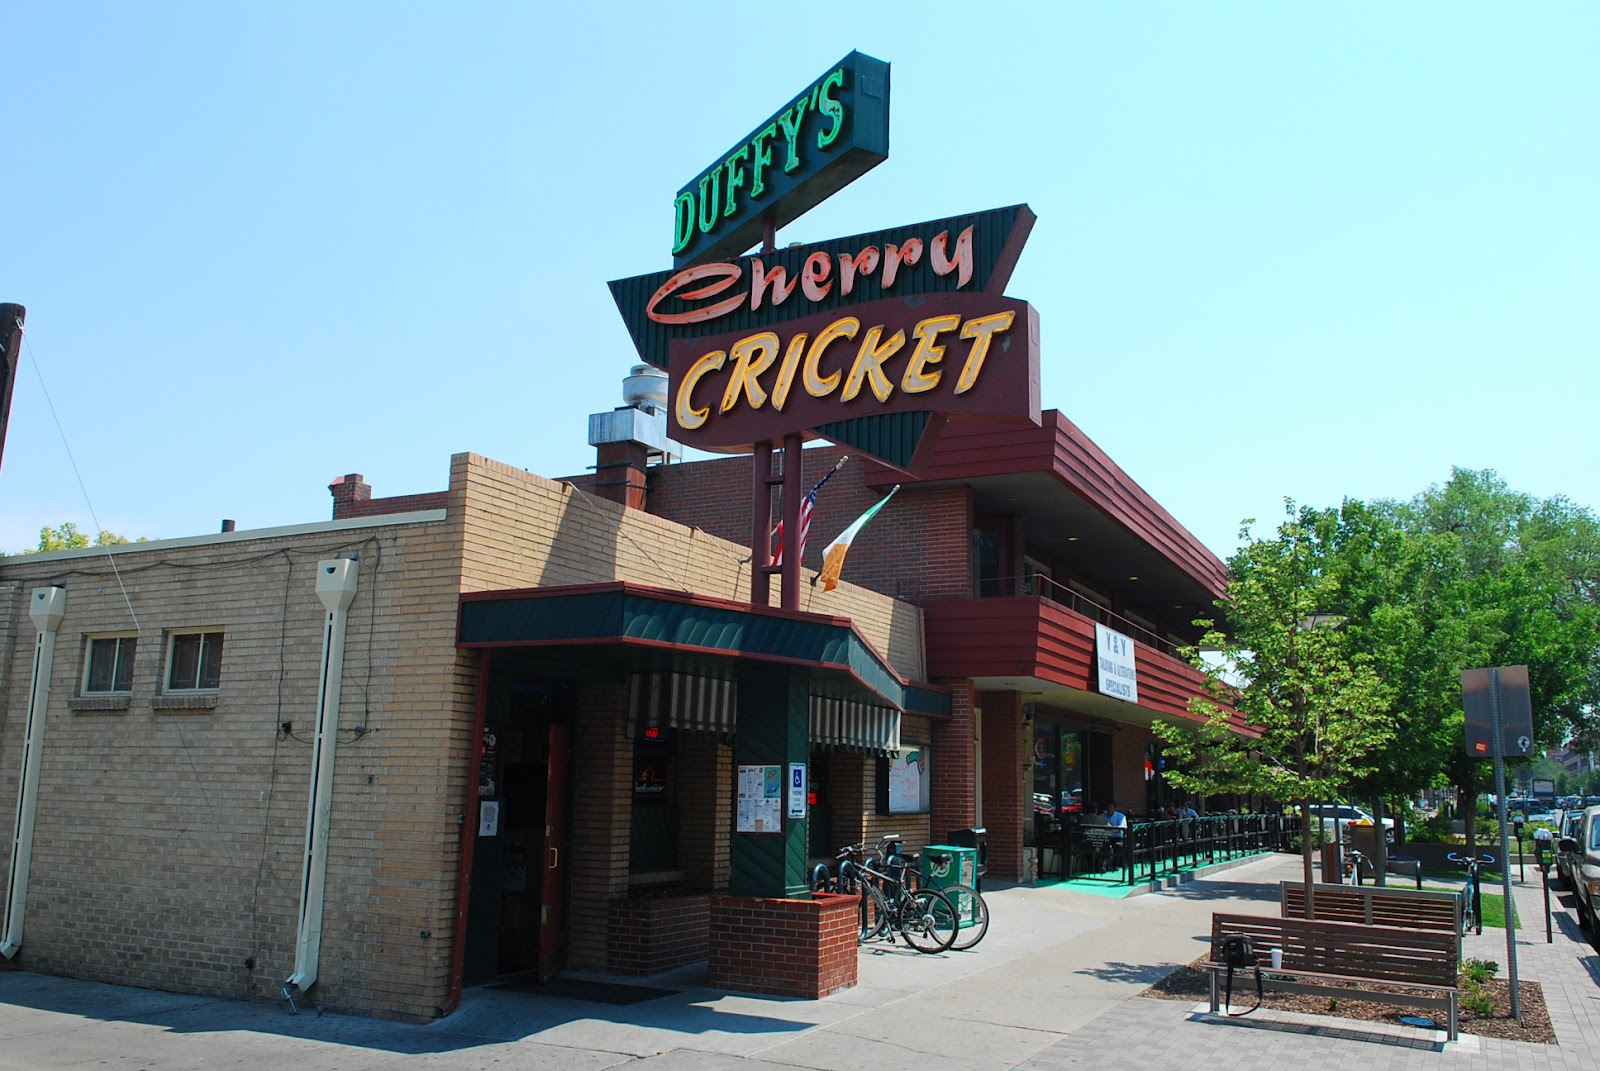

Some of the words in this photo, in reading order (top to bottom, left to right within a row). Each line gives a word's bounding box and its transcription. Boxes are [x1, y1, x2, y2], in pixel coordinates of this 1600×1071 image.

[673, 66, 845, 256] DUFFY'S
[646, 224, 974, 325] Cherry
[675, 310, 1016, 430] CRICKET
[1106, 631, 1111, 651] Y
[1113, 635, 1119, 654] &
[1121, 638, 1126, 656] Y
[1106, 678, 1130, 697] SPECIALISTS
[1342, 824, 1352, 863] NEWS
